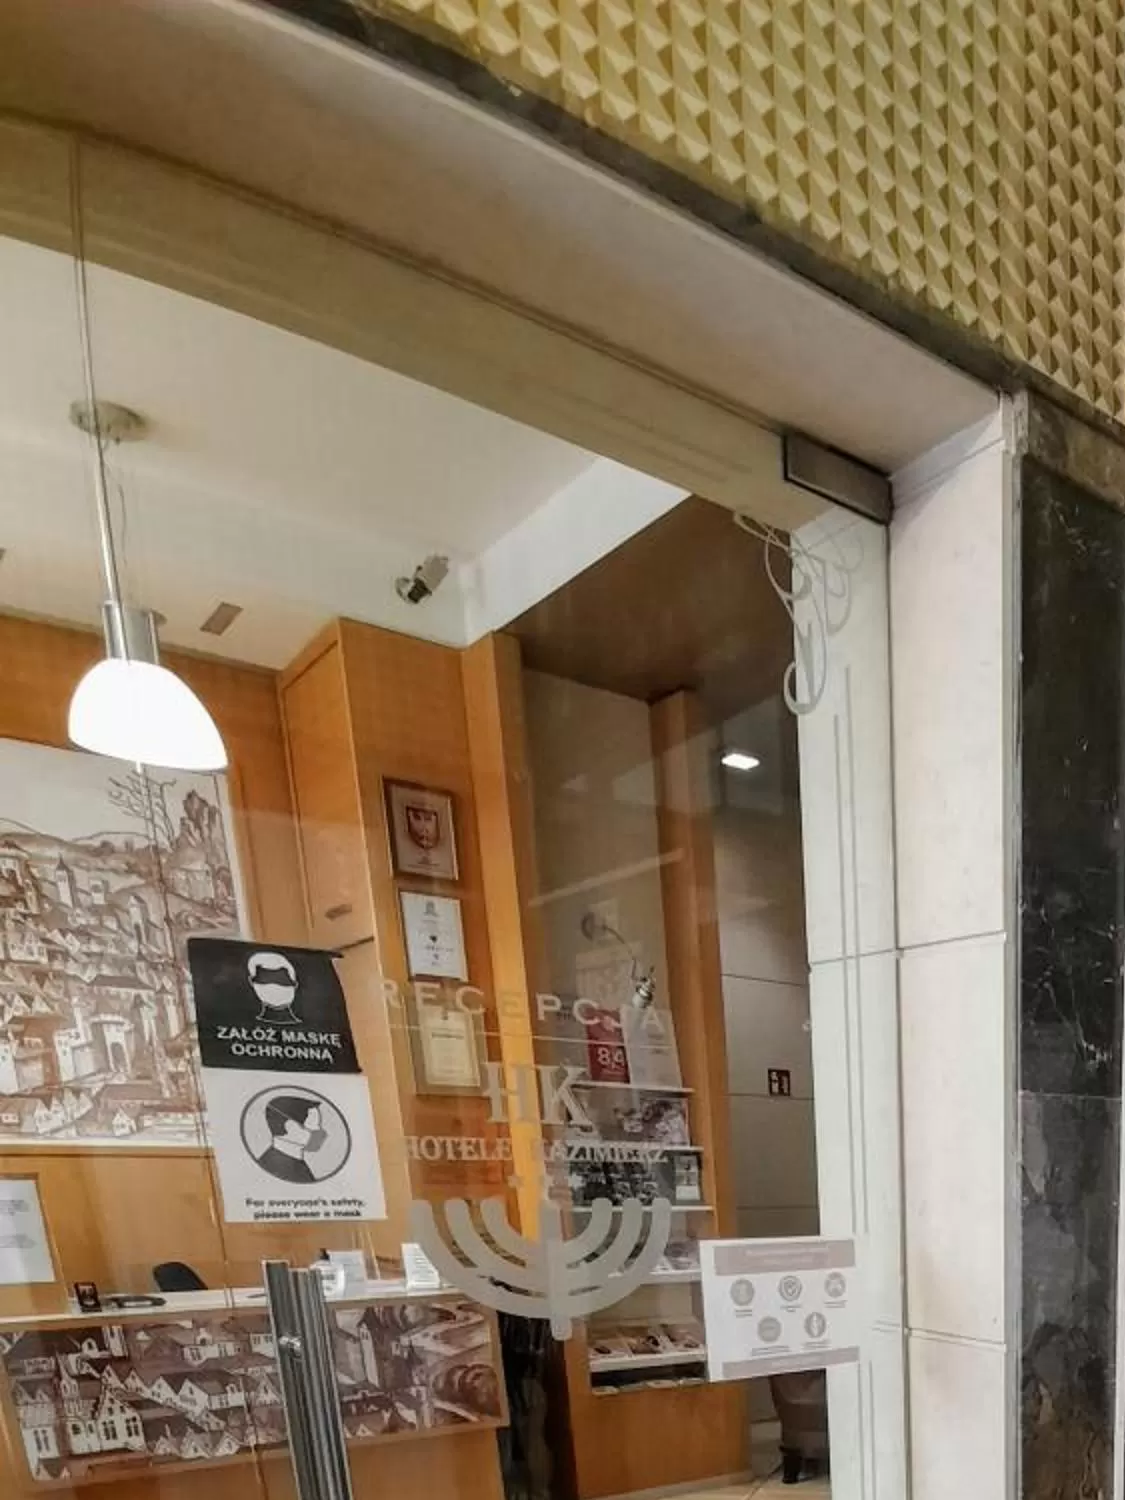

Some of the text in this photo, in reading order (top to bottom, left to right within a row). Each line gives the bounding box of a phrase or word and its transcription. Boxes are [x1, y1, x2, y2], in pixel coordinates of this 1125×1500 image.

[281, 1028, 342, 1048] MASKĘ
[231, 1042, 334, 1064] OCHRONNĄ
[404, 1135, 513, 1162] HOTELE
